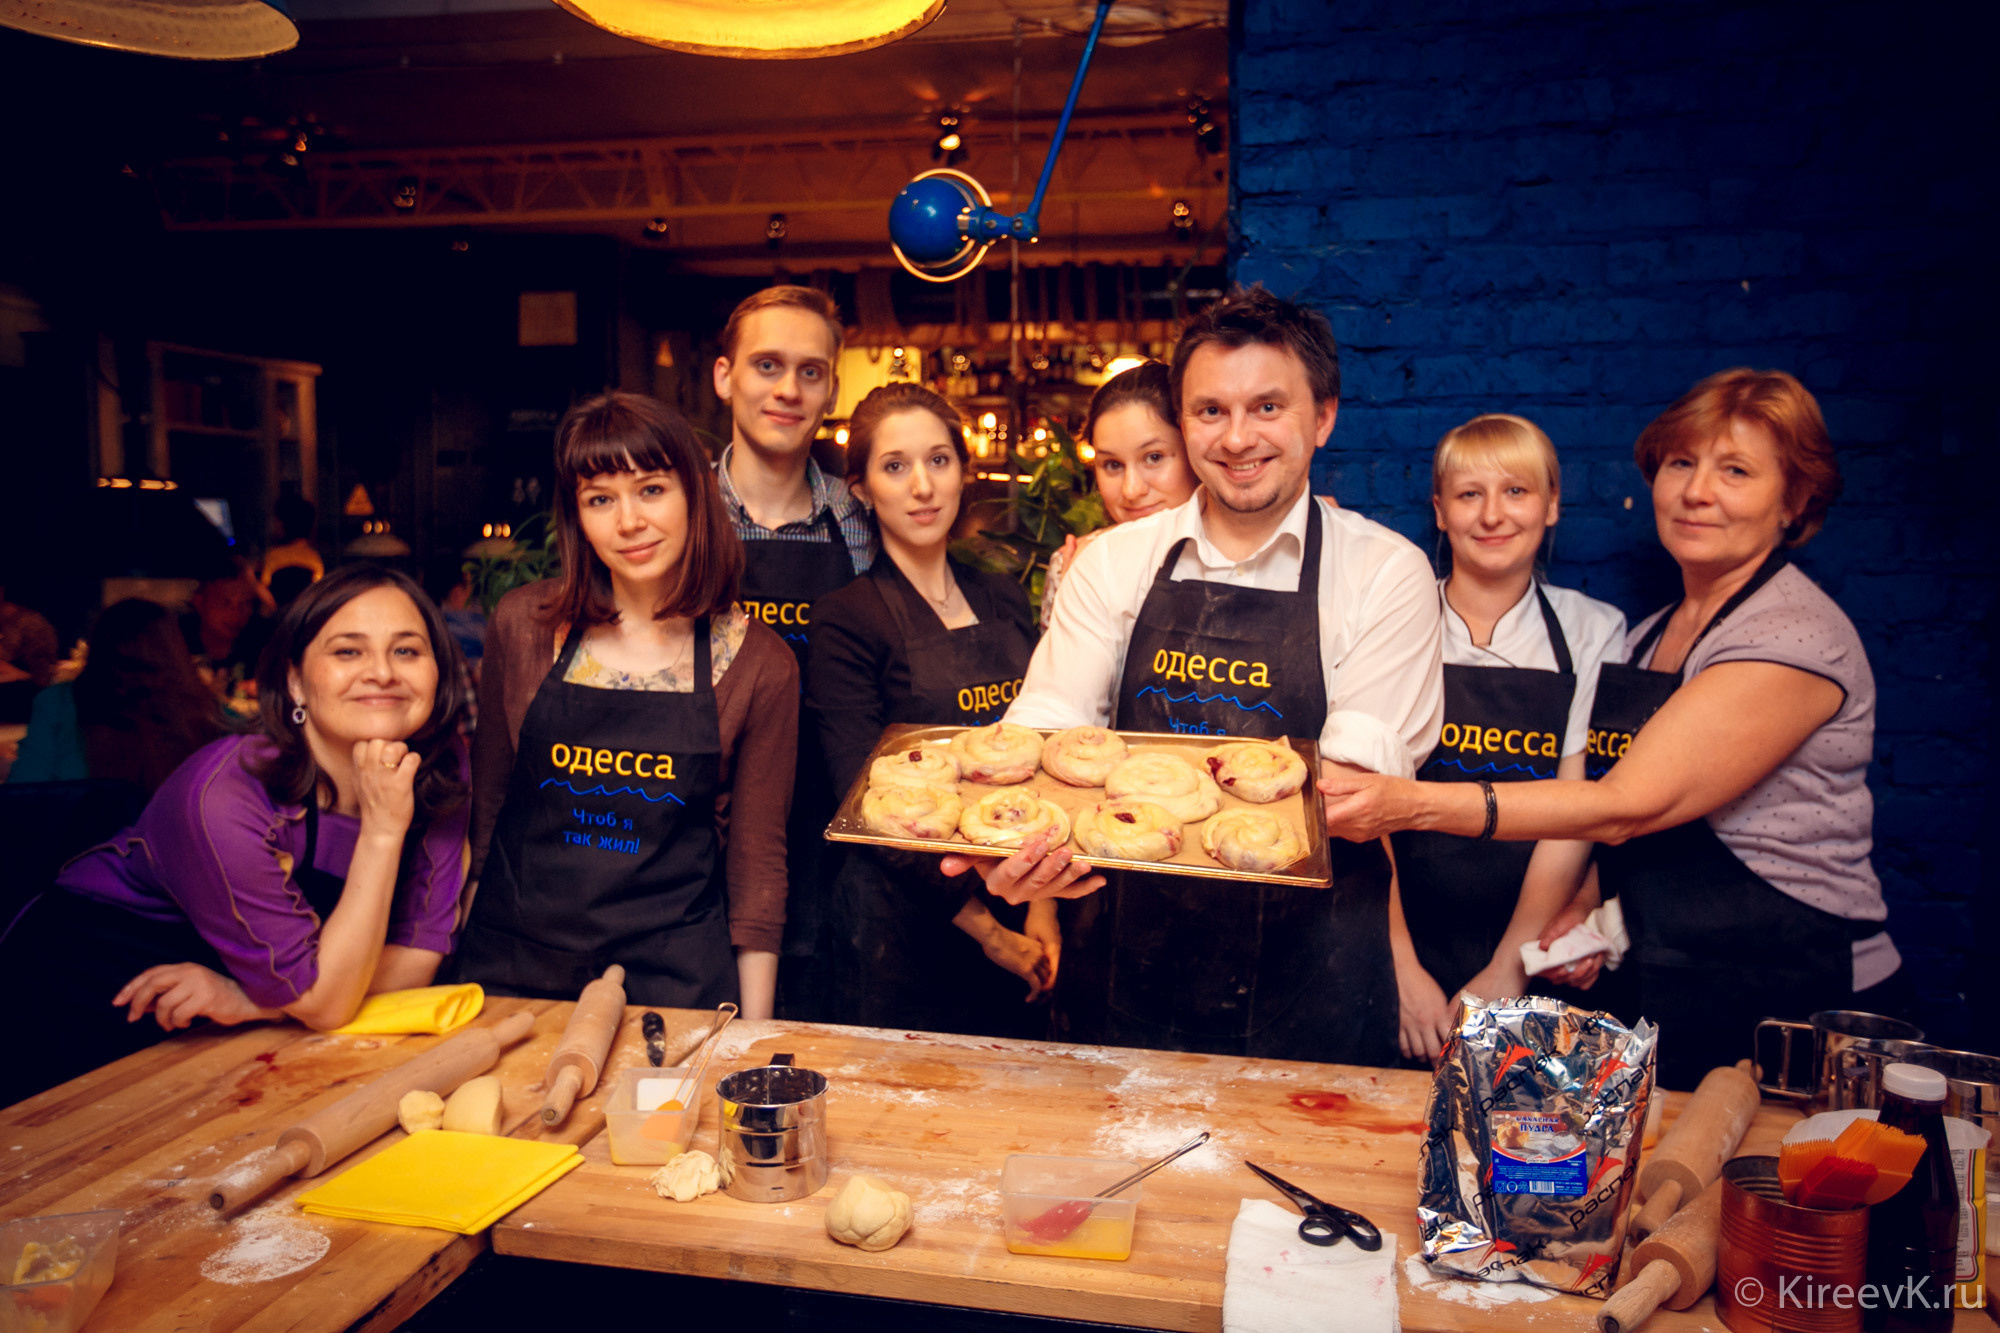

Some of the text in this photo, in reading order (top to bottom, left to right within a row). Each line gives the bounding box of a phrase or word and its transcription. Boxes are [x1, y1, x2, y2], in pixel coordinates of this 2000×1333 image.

[733, 600, 810, 625] десс
[1153, 649, 1272, 688] одесса
[957, 678, 1023, 713] одесс
[1441, 722, 1558, 758] одесса
[1587, 728, 1632, 758] есса
[551, 743, 677, 780] одесса
[573, 808, 634, 831] Чтоб я
[563, 830, 641, 854] так жил!
